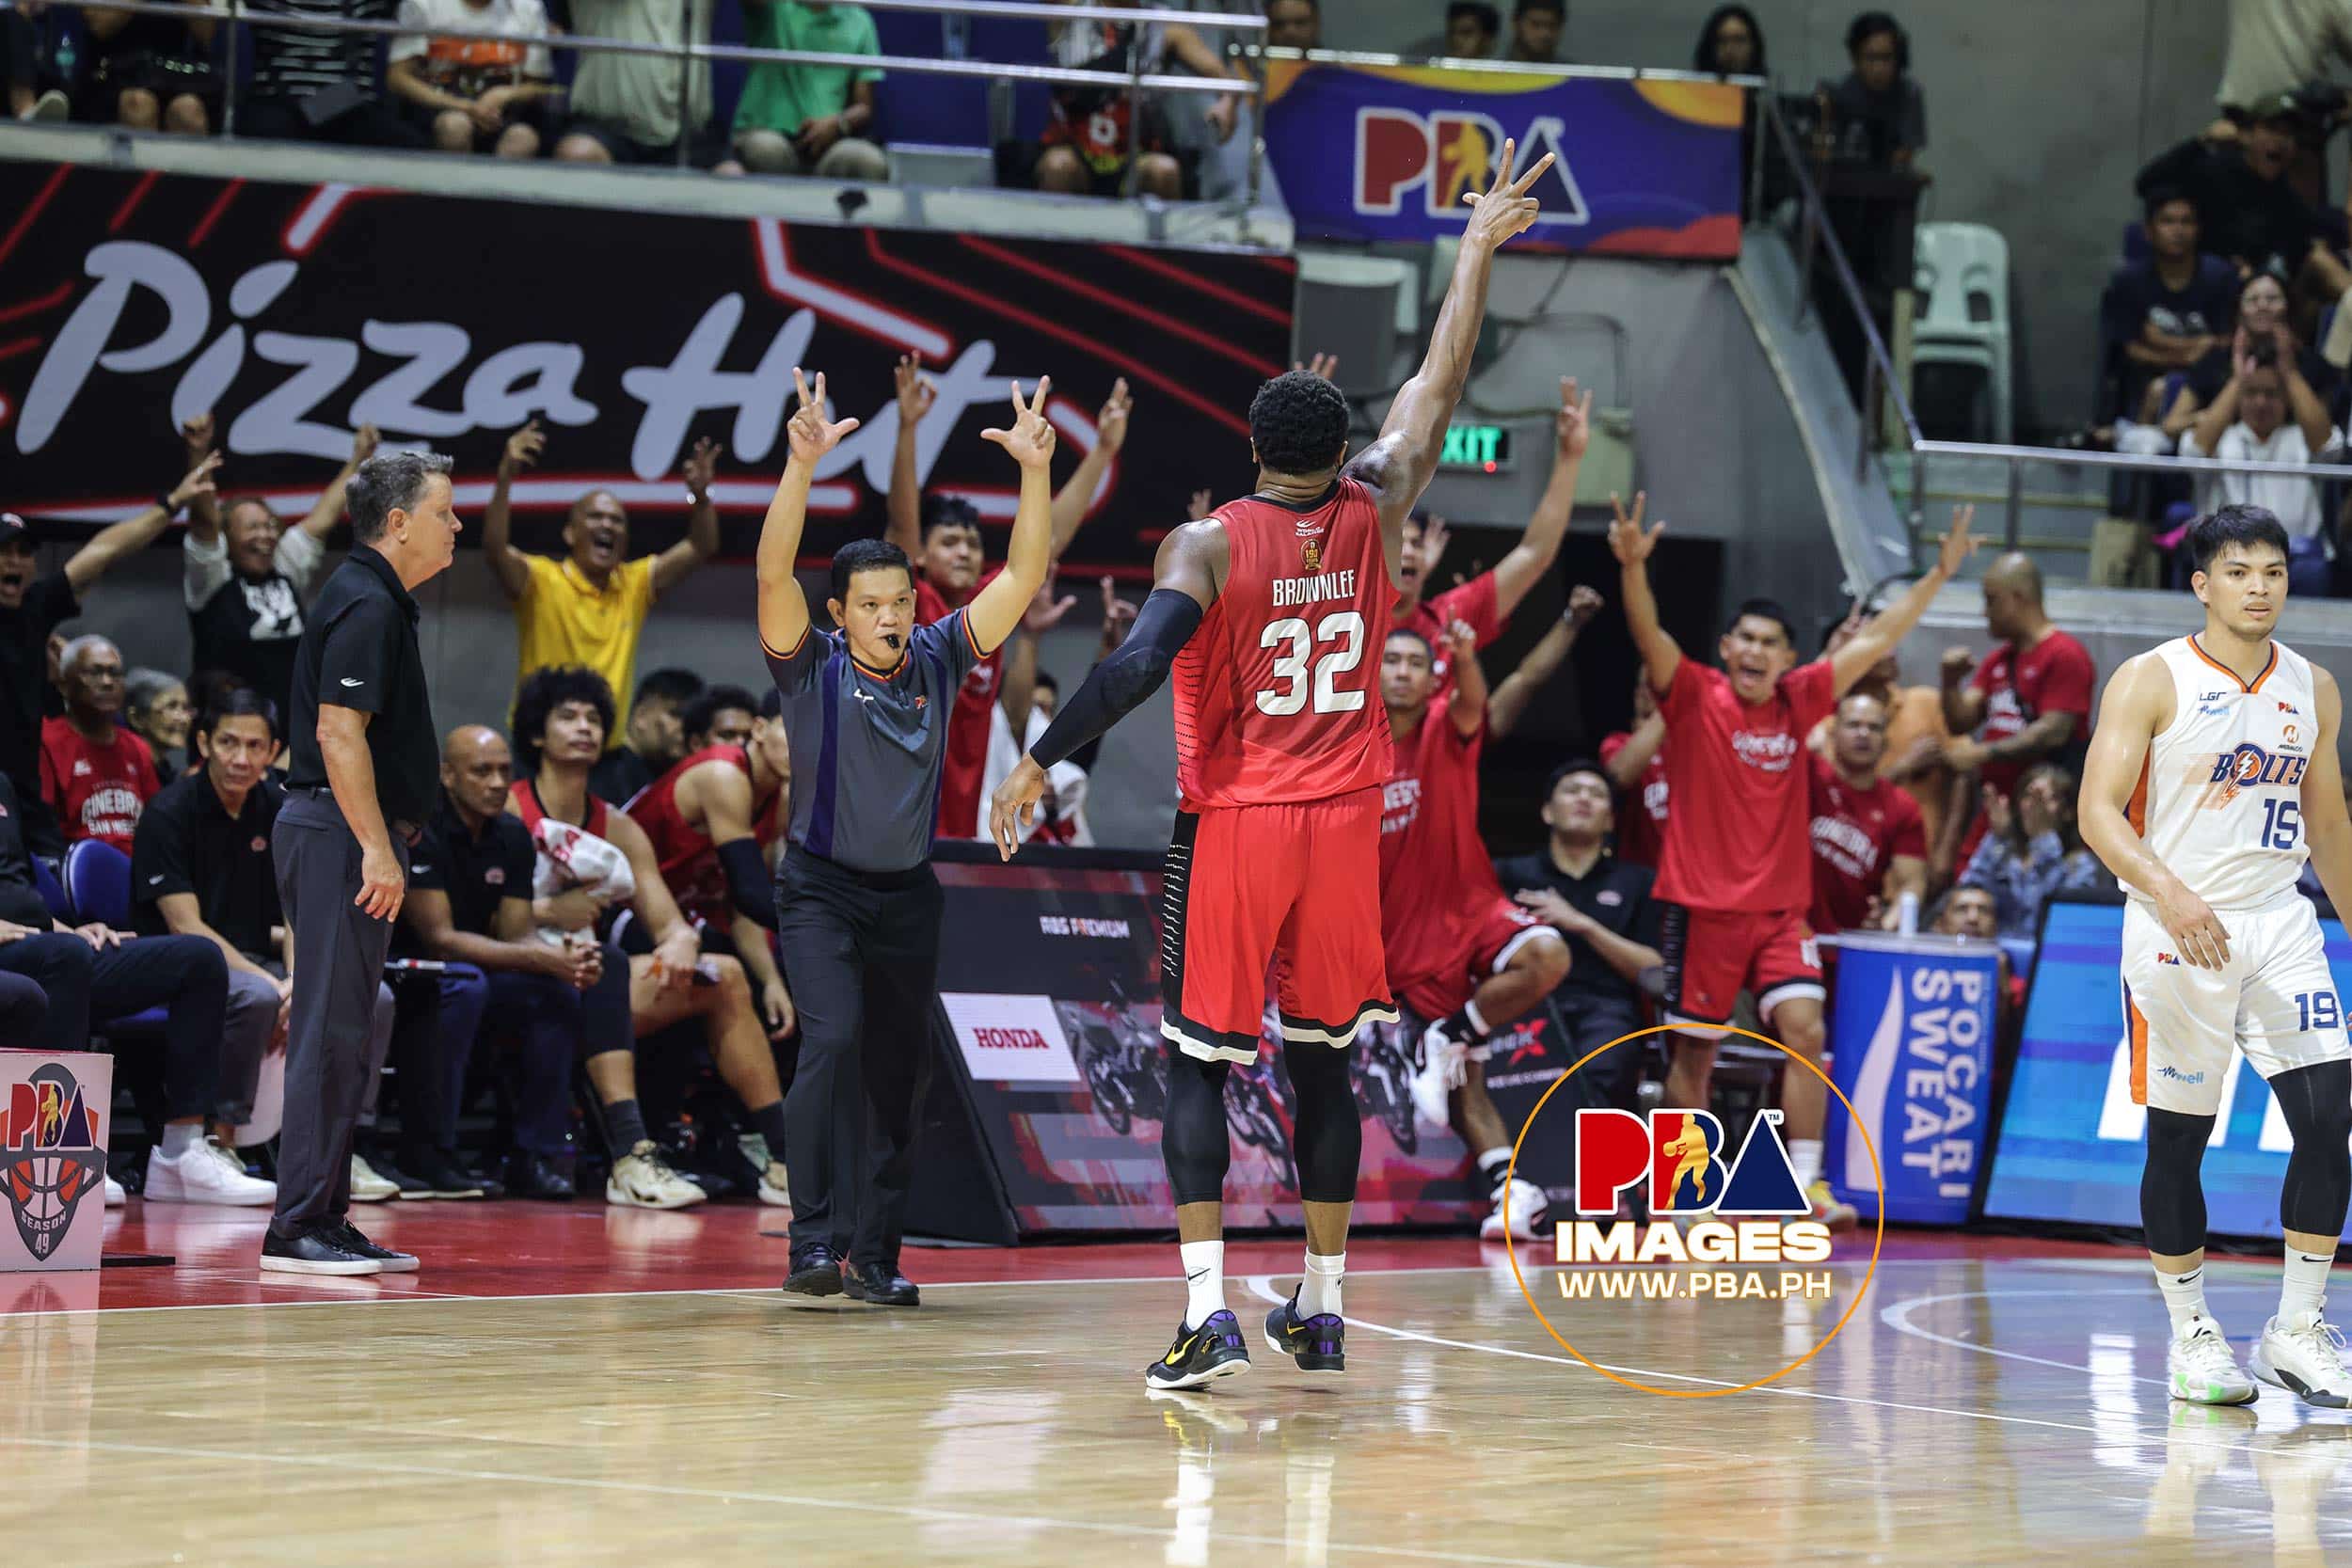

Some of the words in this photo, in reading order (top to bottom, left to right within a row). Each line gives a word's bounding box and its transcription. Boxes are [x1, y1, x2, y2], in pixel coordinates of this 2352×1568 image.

[1354, 106, 1590, 225] PBA
[15, 241, 599, 454] Pizza
[1440, 426, 1502, 465] XIT
[1273, 570, 1355, 607] BROWNLEE
[1255, 610, 1365, 716] 32
[2278, 702, 2299, 715] PBA
[2210, 743, 2307, 786] BOLTS
[2261, 799, 2299, 849] 19
[2158, 952, 2180, 965] PBA
[2296, 991, 2339, 1031] 19
[972, 1027, 1050, 1049] HONDA
[1901, 967, 1952, 1179] SWEAT
[1938, 970, 1982, 1198] POCARI
[7, 1080, 93, 1151] PBA
[22, 1211, 67, 1231] SEASON
[35, 1233, 50, 1256] 49
